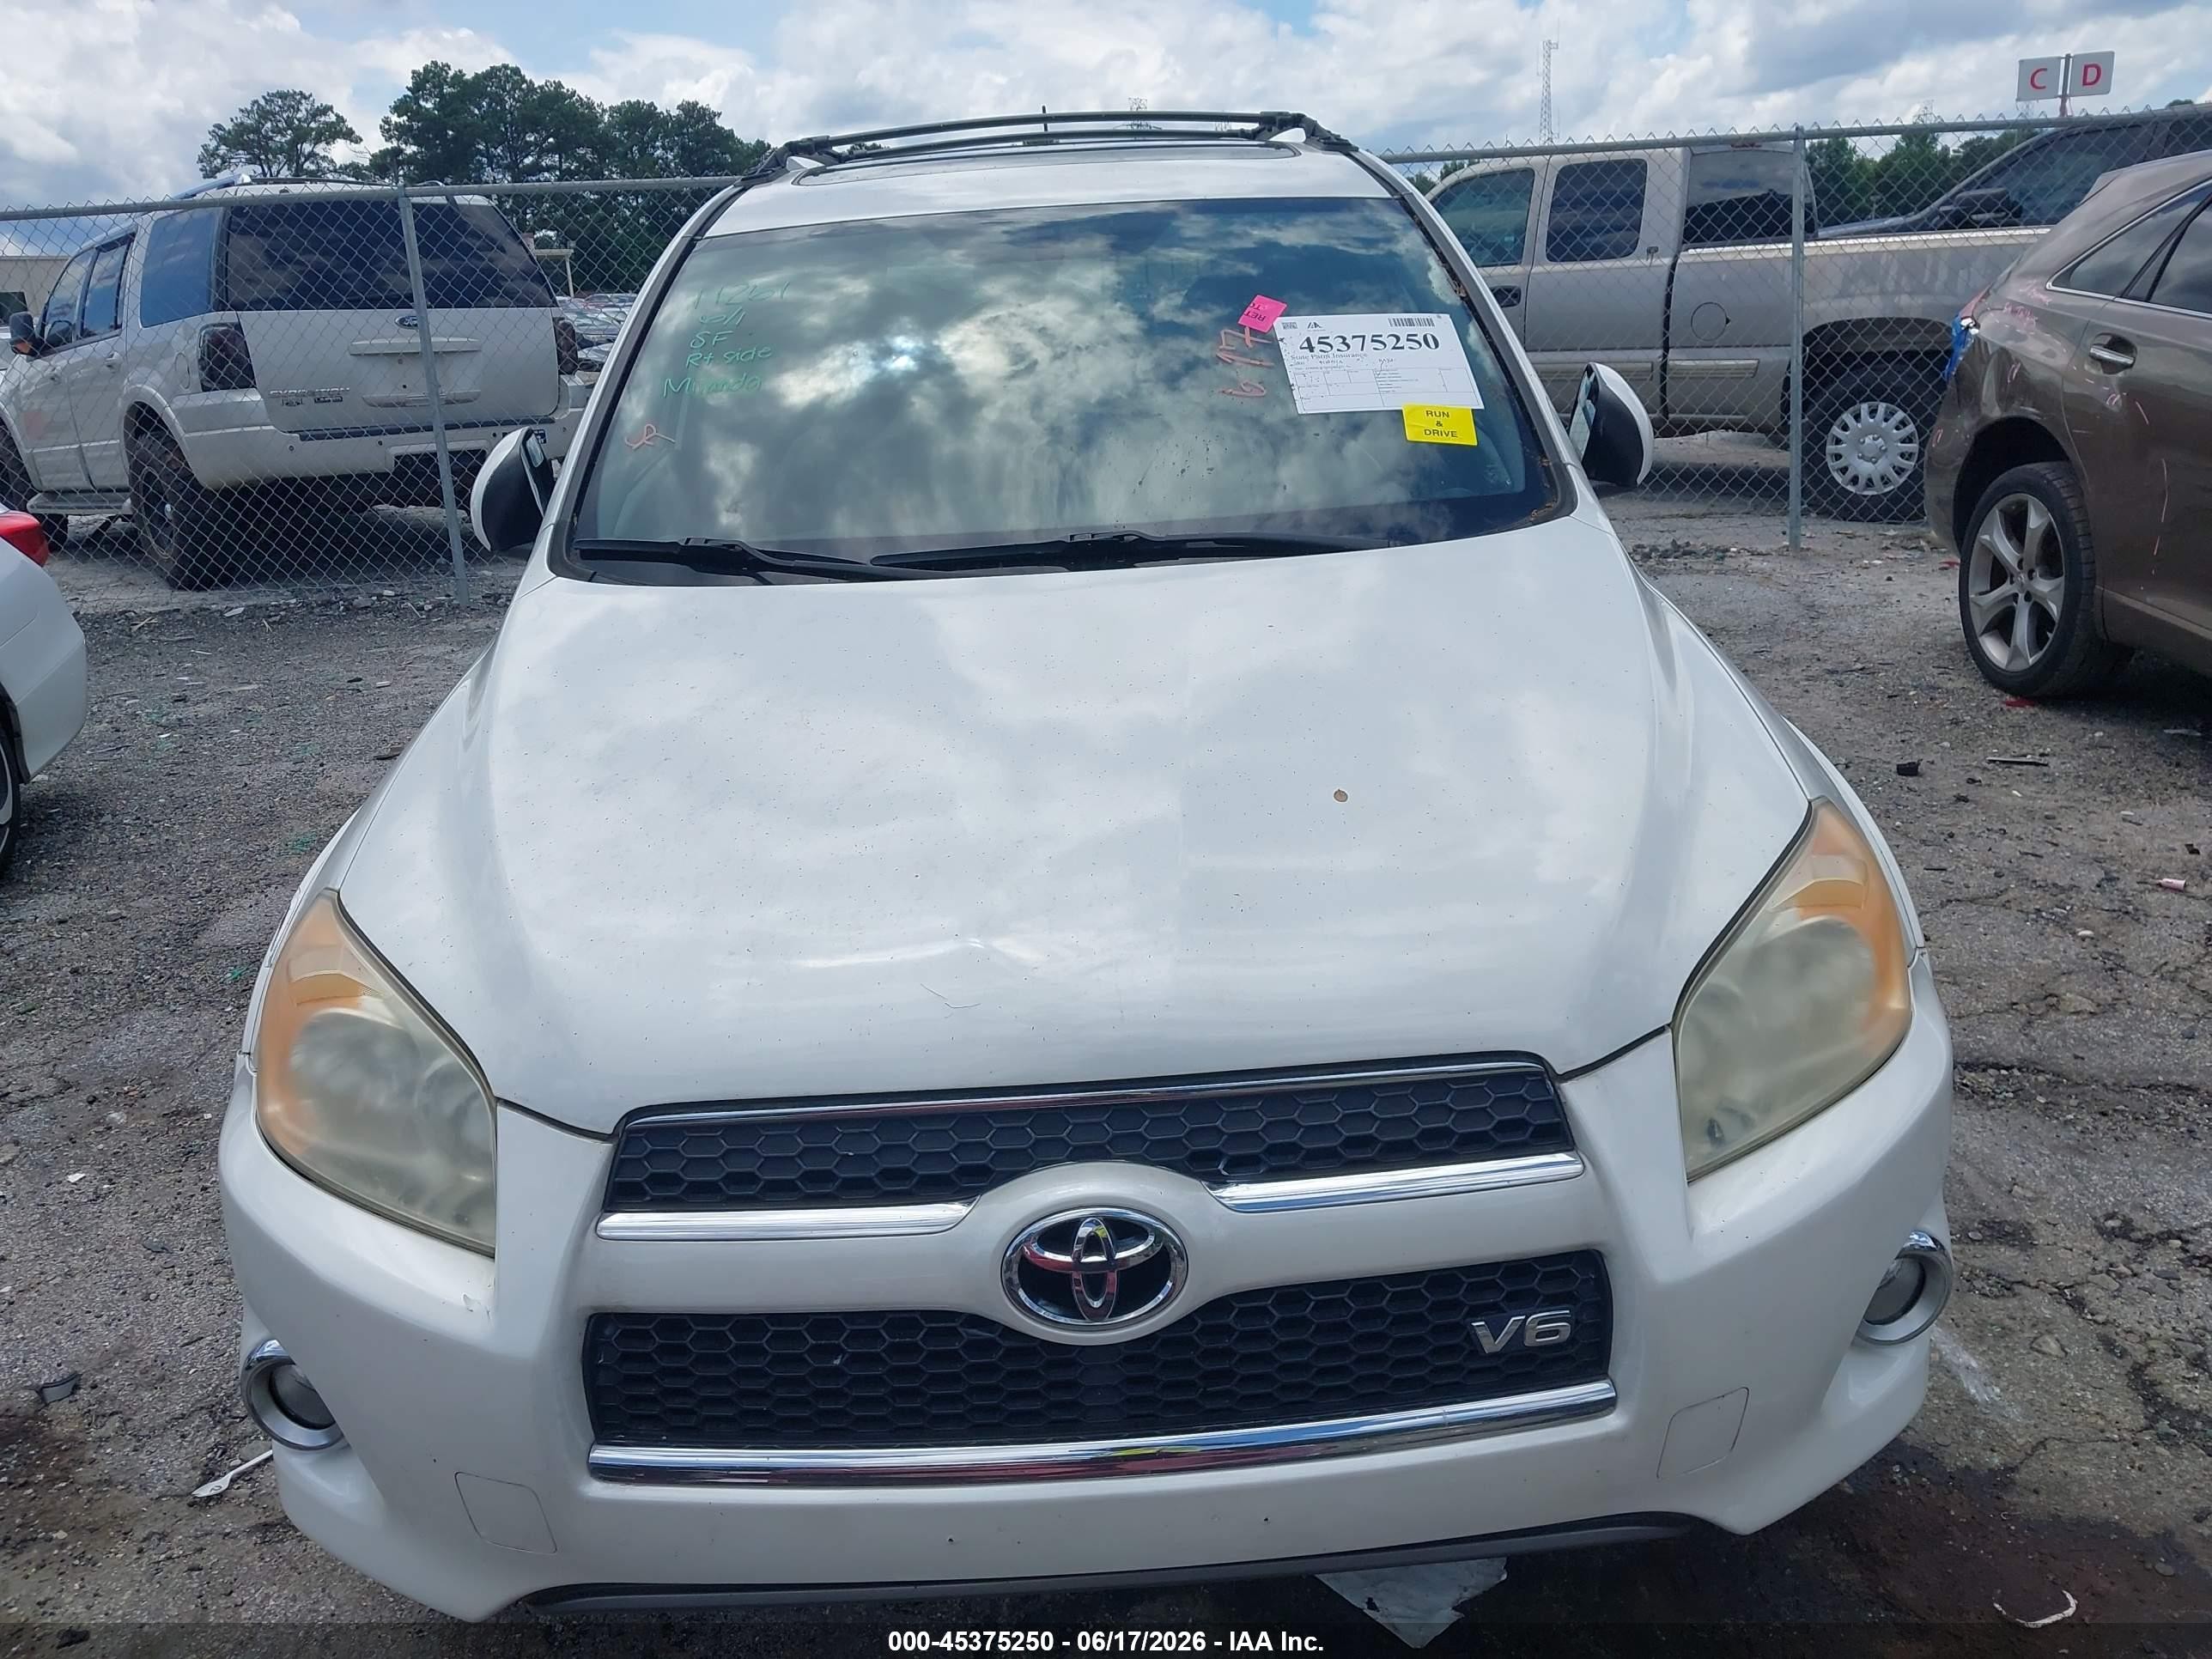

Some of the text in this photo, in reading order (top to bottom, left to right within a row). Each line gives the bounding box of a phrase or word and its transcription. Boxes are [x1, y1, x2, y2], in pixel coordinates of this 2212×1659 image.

[2030, 68, 2048, 90] C
[2081, 63, 2102, 87] D
[1298, 332, 1440, 353] 45375250
[1425, 410, 1450, 418] RUN
[1423, 428, 1458, 438] DRIVE
[1471, 1310, 1571, 1354] V6
